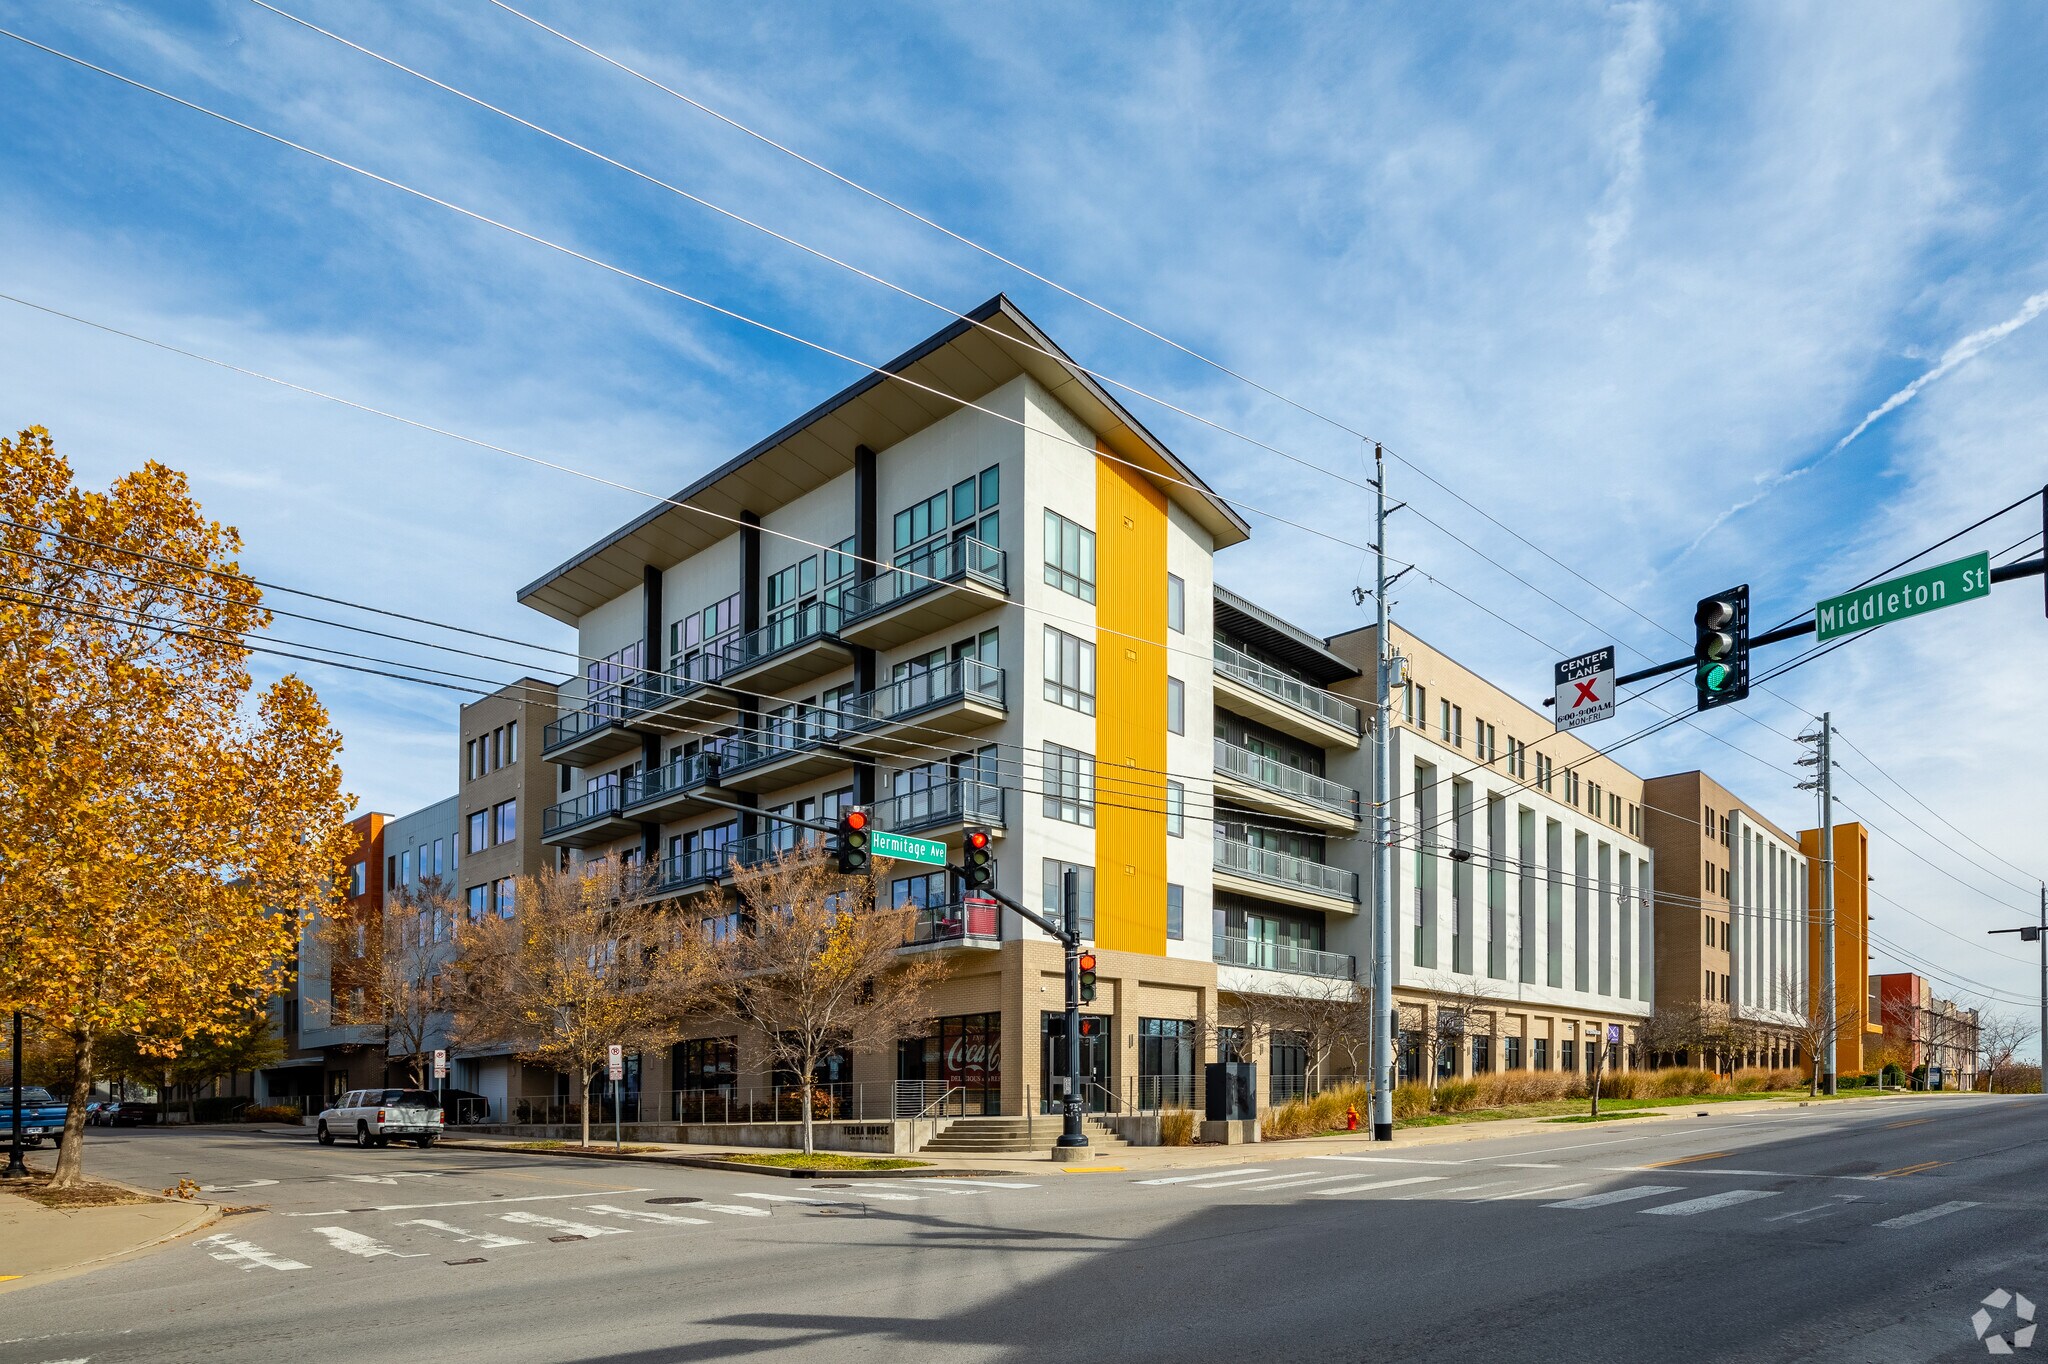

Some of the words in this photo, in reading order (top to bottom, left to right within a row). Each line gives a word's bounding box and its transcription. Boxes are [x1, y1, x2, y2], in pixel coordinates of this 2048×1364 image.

[1820, 580, 1946, 633] Middleton
[1962, 567, 1985, 593] St
[1561, 651, 1608, 673] CENTER
[1568, 663, 1601, 681] LANE
[1568, 712, 1601, 727] MON-FRI
[873, 833, 926, 859] Hermitage
[930, 845, 945, 858] Ave
[843, 1126, 865, 1136] TERRA
[866, 1126, 889, 1136] HOUSE
